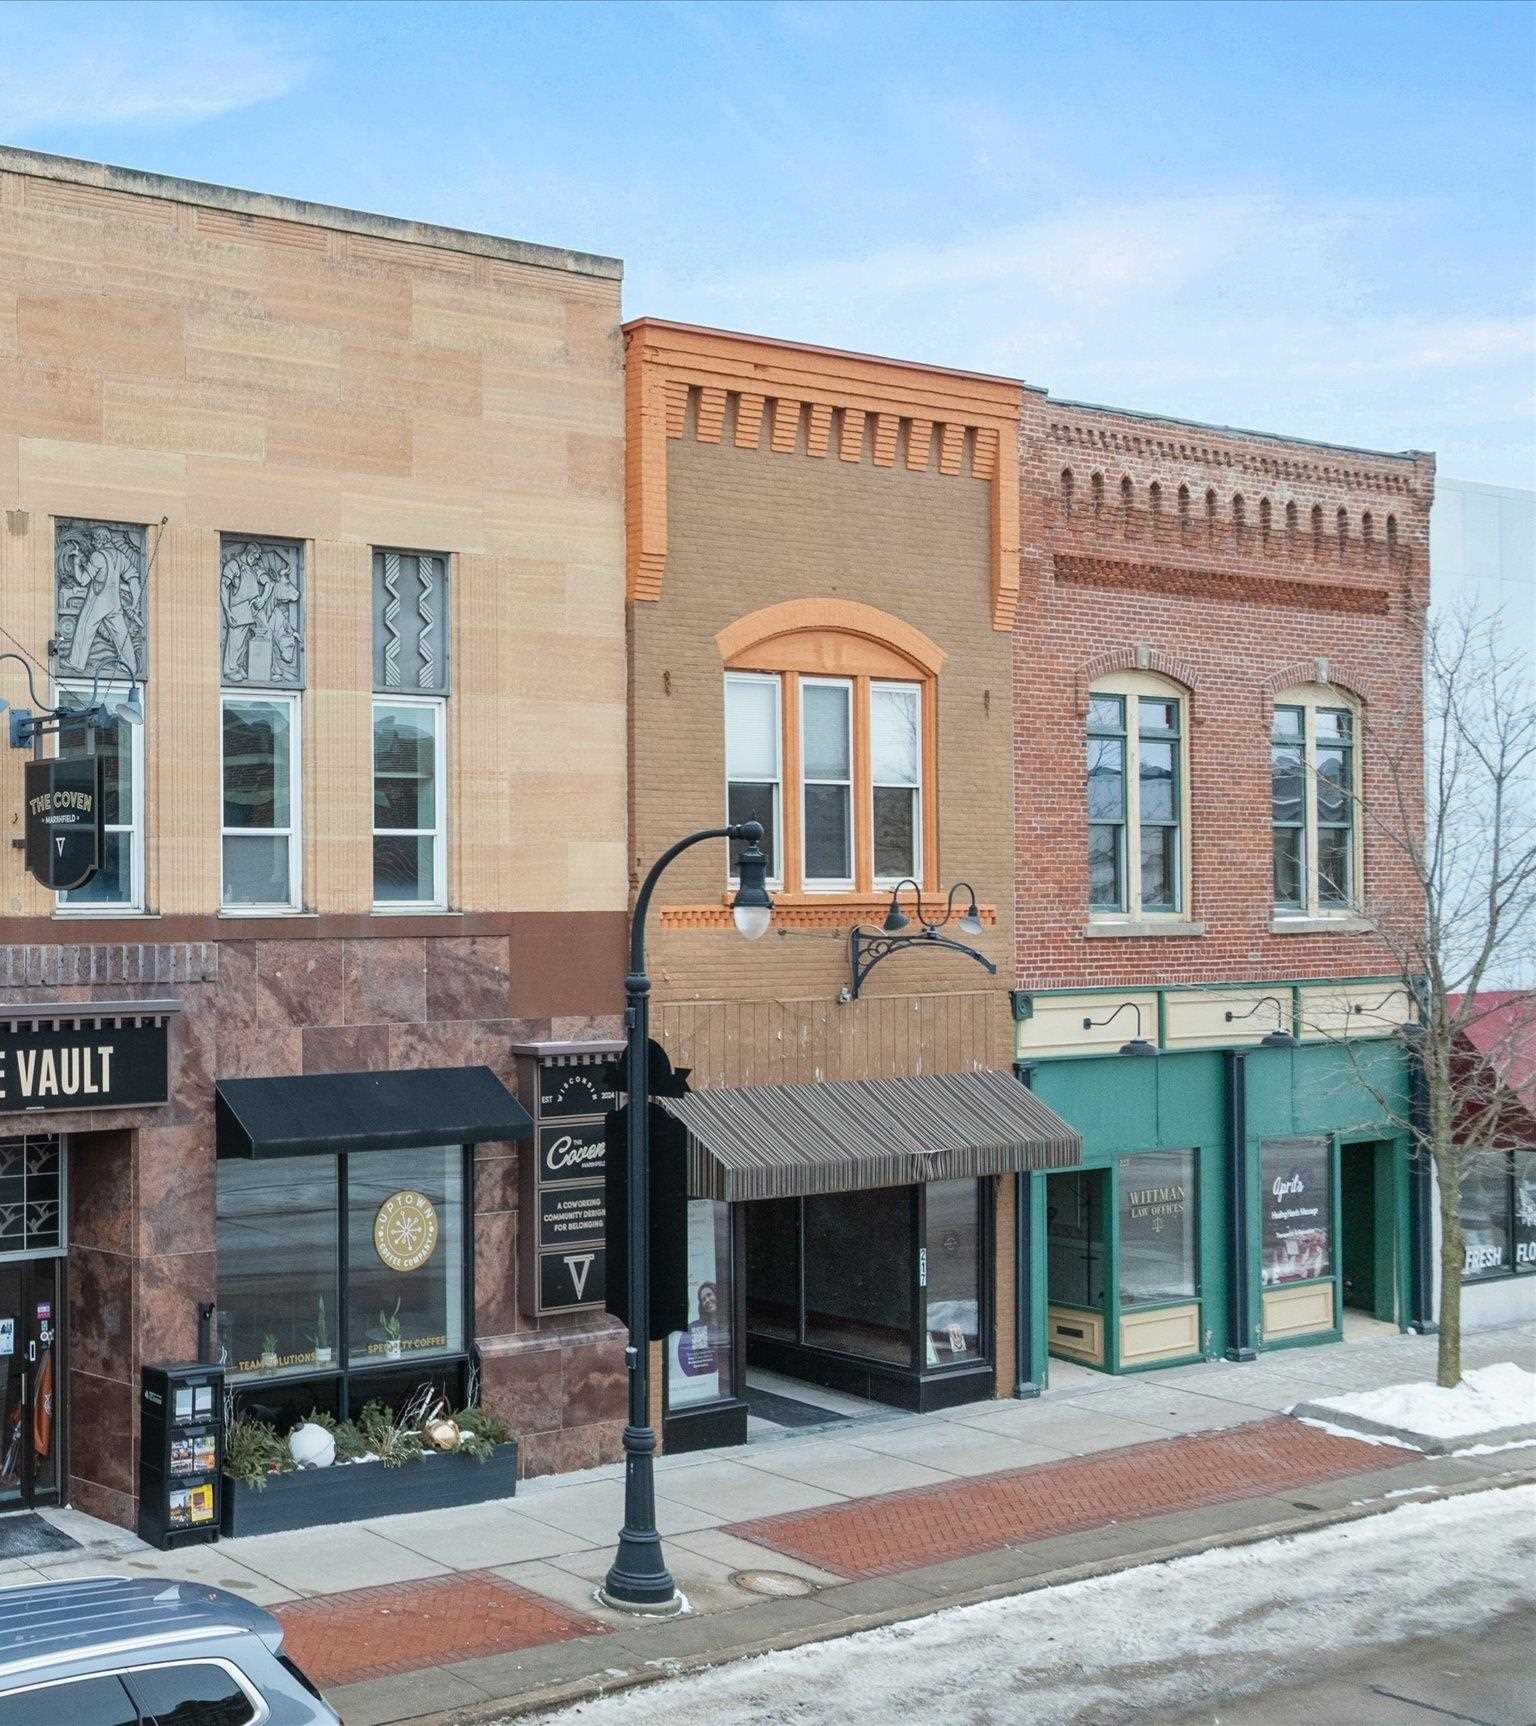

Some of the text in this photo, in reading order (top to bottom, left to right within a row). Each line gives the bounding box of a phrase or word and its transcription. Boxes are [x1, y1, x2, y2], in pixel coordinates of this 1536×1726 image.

[29, 791, 93, 815] THE COVEN
[45, 815, 76, 824] MARSHFIELD
[16, 1046, 114, 1097] VAULT
[557, 1076, 598, 1102] WISCONSIN
[546, 1136, 606, 1170] Coven
[557, 1198, 601, 1210] A COWORKING
[1130, 1184, 1185, 1205] WITTMAN
[378, 1194, 434, 1223] UPTOWN
[544, 1211, 583, 1222] COMMUNITY
[1131, 1204, 1185, 1218] LAW OFFICES
[554, 1220, 604, 1232] FOR BELONGING
[1465, 1246, 1503, 1271] FRESH
[368, 1335, 446, 1354] SPETY COFFEE
[239, 1359, 264, 1371] TEAM
